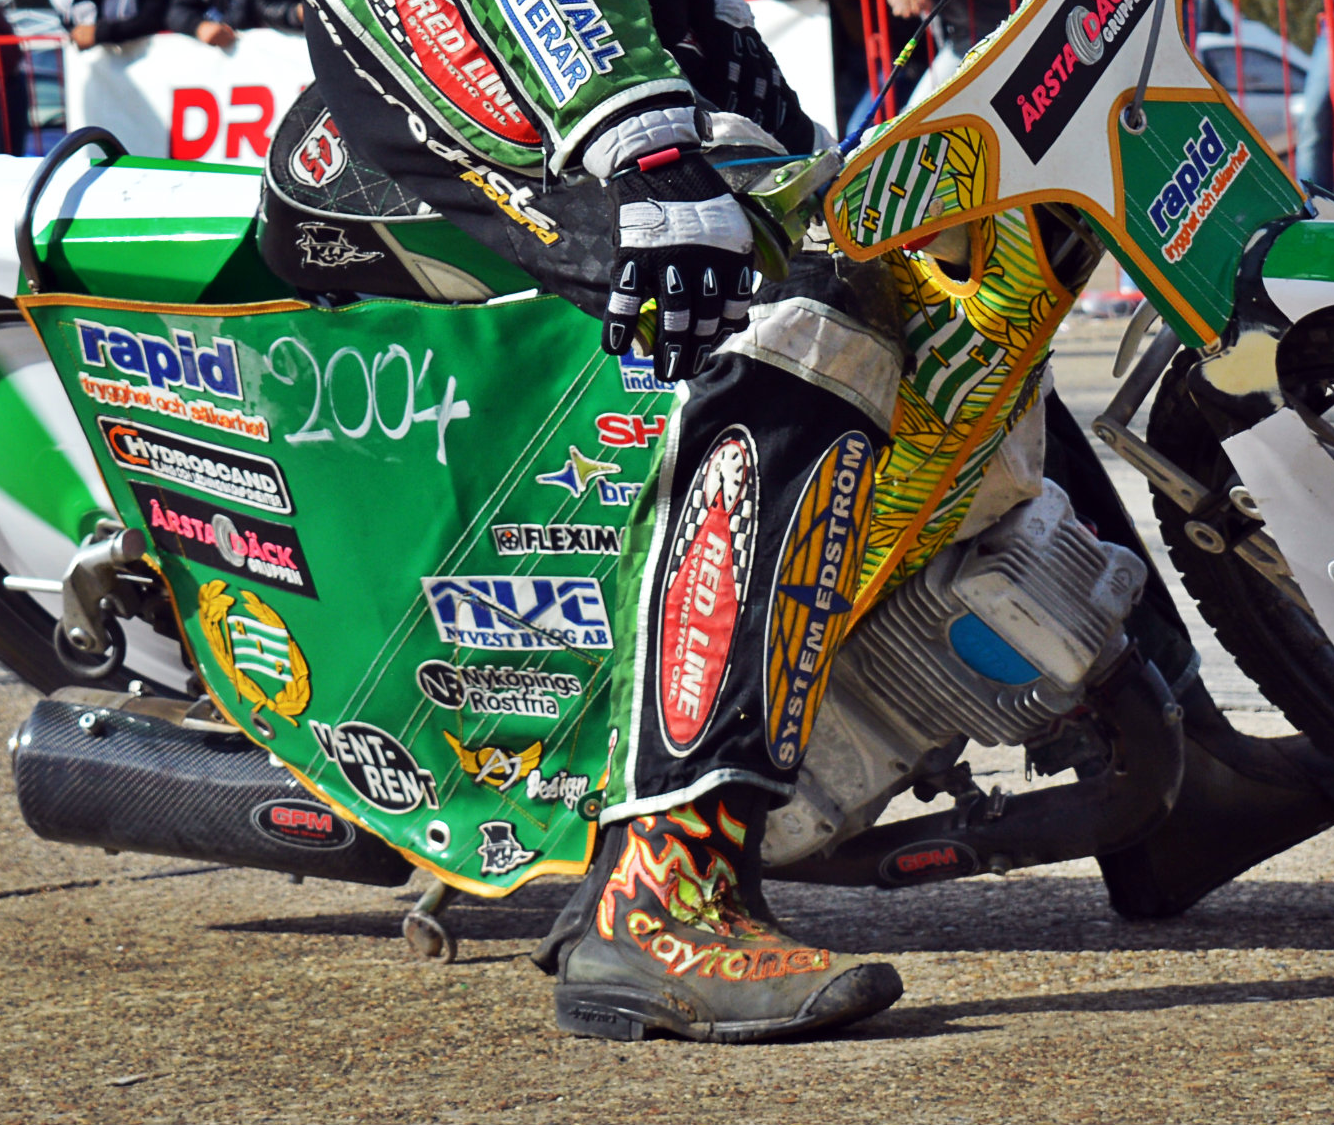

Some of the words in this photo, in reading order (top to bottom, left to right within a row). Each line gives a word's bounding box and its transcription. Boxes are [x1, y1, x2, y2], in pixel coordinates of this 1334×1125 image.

[406, 15, 479, 98] SYNTHETIC
[482, 100, 509, 127] OIL
[1017, 42, 1079, 133] ÅRSTA
[171, 85, 307, 161] DR
[1148, 118, 1225, 235] rapid
[1196, 191, 1217, 218] och
[76, 320, 242, 398] rapid
[155, 396, 188, 417] och
[263, 336, 470, 465] 2004
[123, 435, 278, 494] HYDROSCAND
[150, 498, 218, 546] ÅRSTA
[230, 530, 298, 570] DÄCK
[524, 527, 624, 553] FLEXIM
[674, 542, 702, 660] SYNTHETIC
[695, 531, 727, 617] RED
[778, 623, 825, 764] SYSTEM
[815, 437, 866, 611] EDSTRÖM
[444, 626, 516, 648] NYVEST
[582, 629, 609, 645] AB
[471, 690, 557, 715] Rostfria
[668, 665, 682, 701] OIL
[676, 626, 710, 722] LINE
[310, 721, 397, 765] VENT-
[271, 806, 332, 833] GPM
[362, 765, 438, 809] RENT
[897, 846, 959, 873] GPM
[627, 908, 830, 982] daytona
